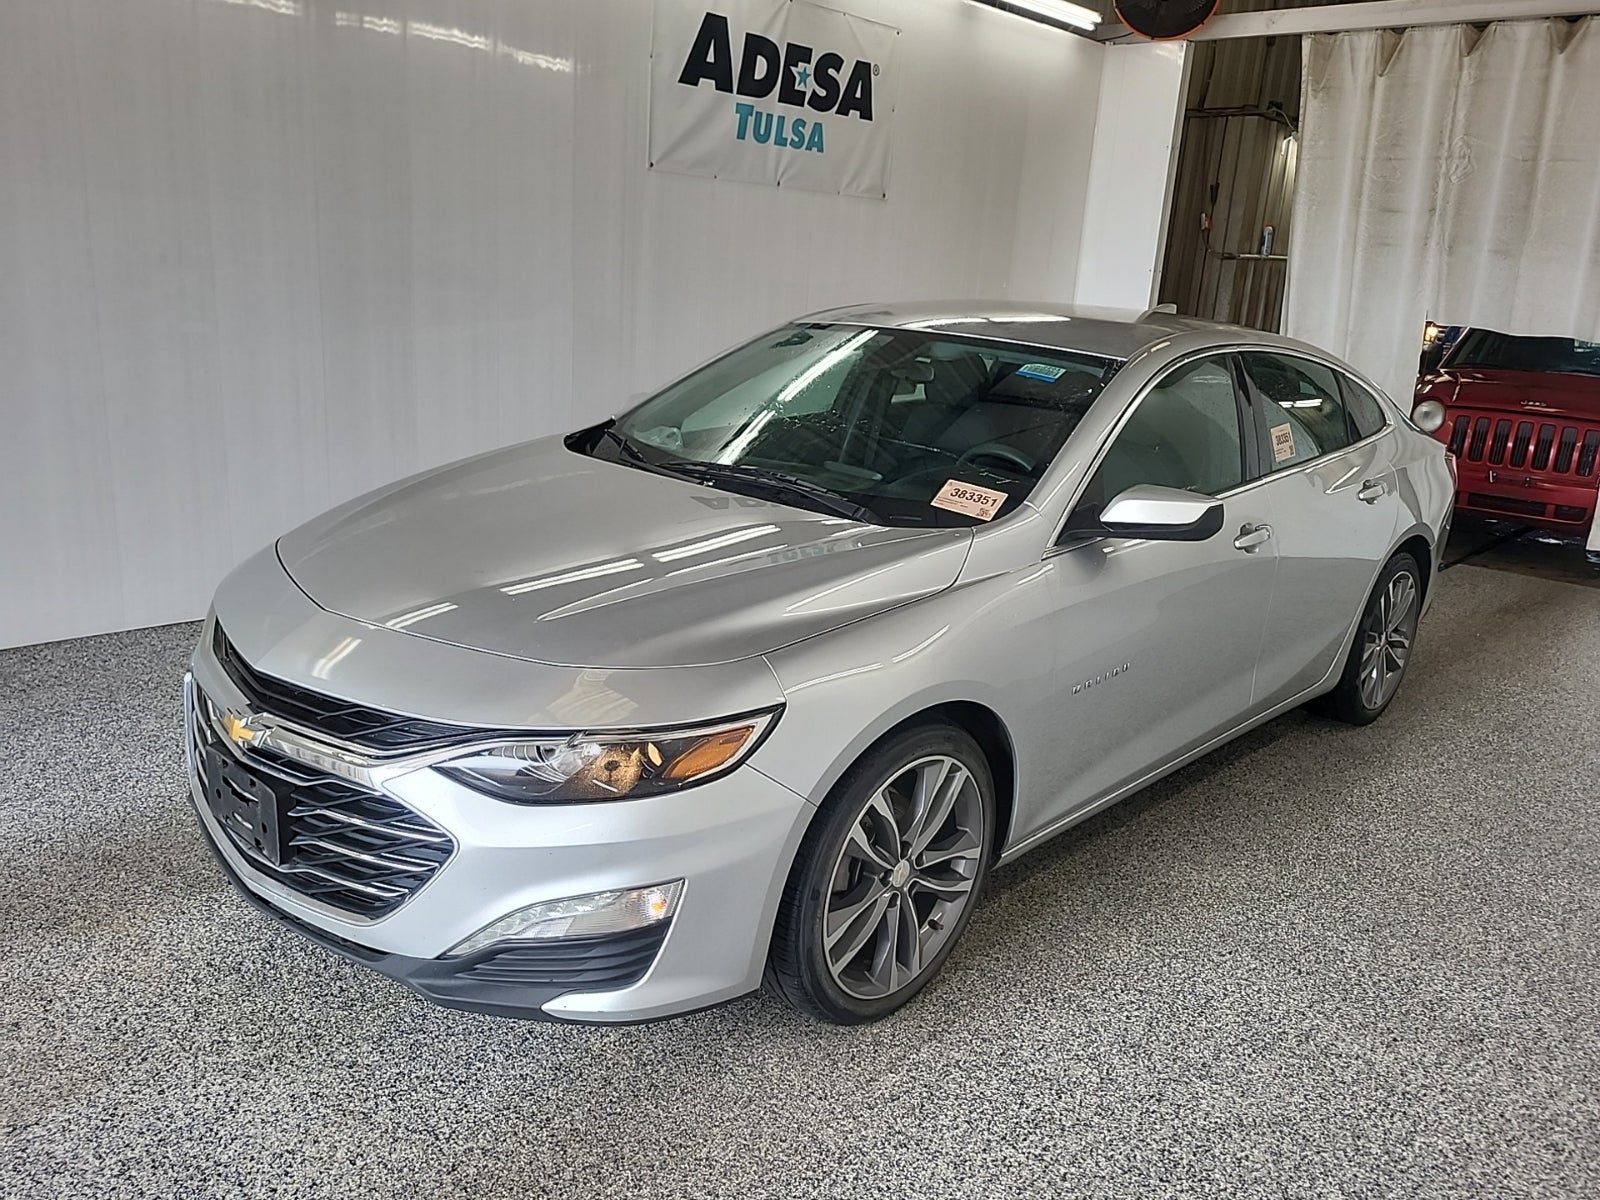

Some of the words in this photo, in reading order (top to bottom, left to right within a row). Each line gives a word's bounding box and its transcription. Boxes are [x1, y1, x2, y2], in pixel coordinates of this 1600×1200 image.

[678, 12, 874, 121] ADESA
[734, 102, 825, 153] TULSA
[1275, 432, 1292, 446] 383351
[950, 487, 998, 507] 383351
